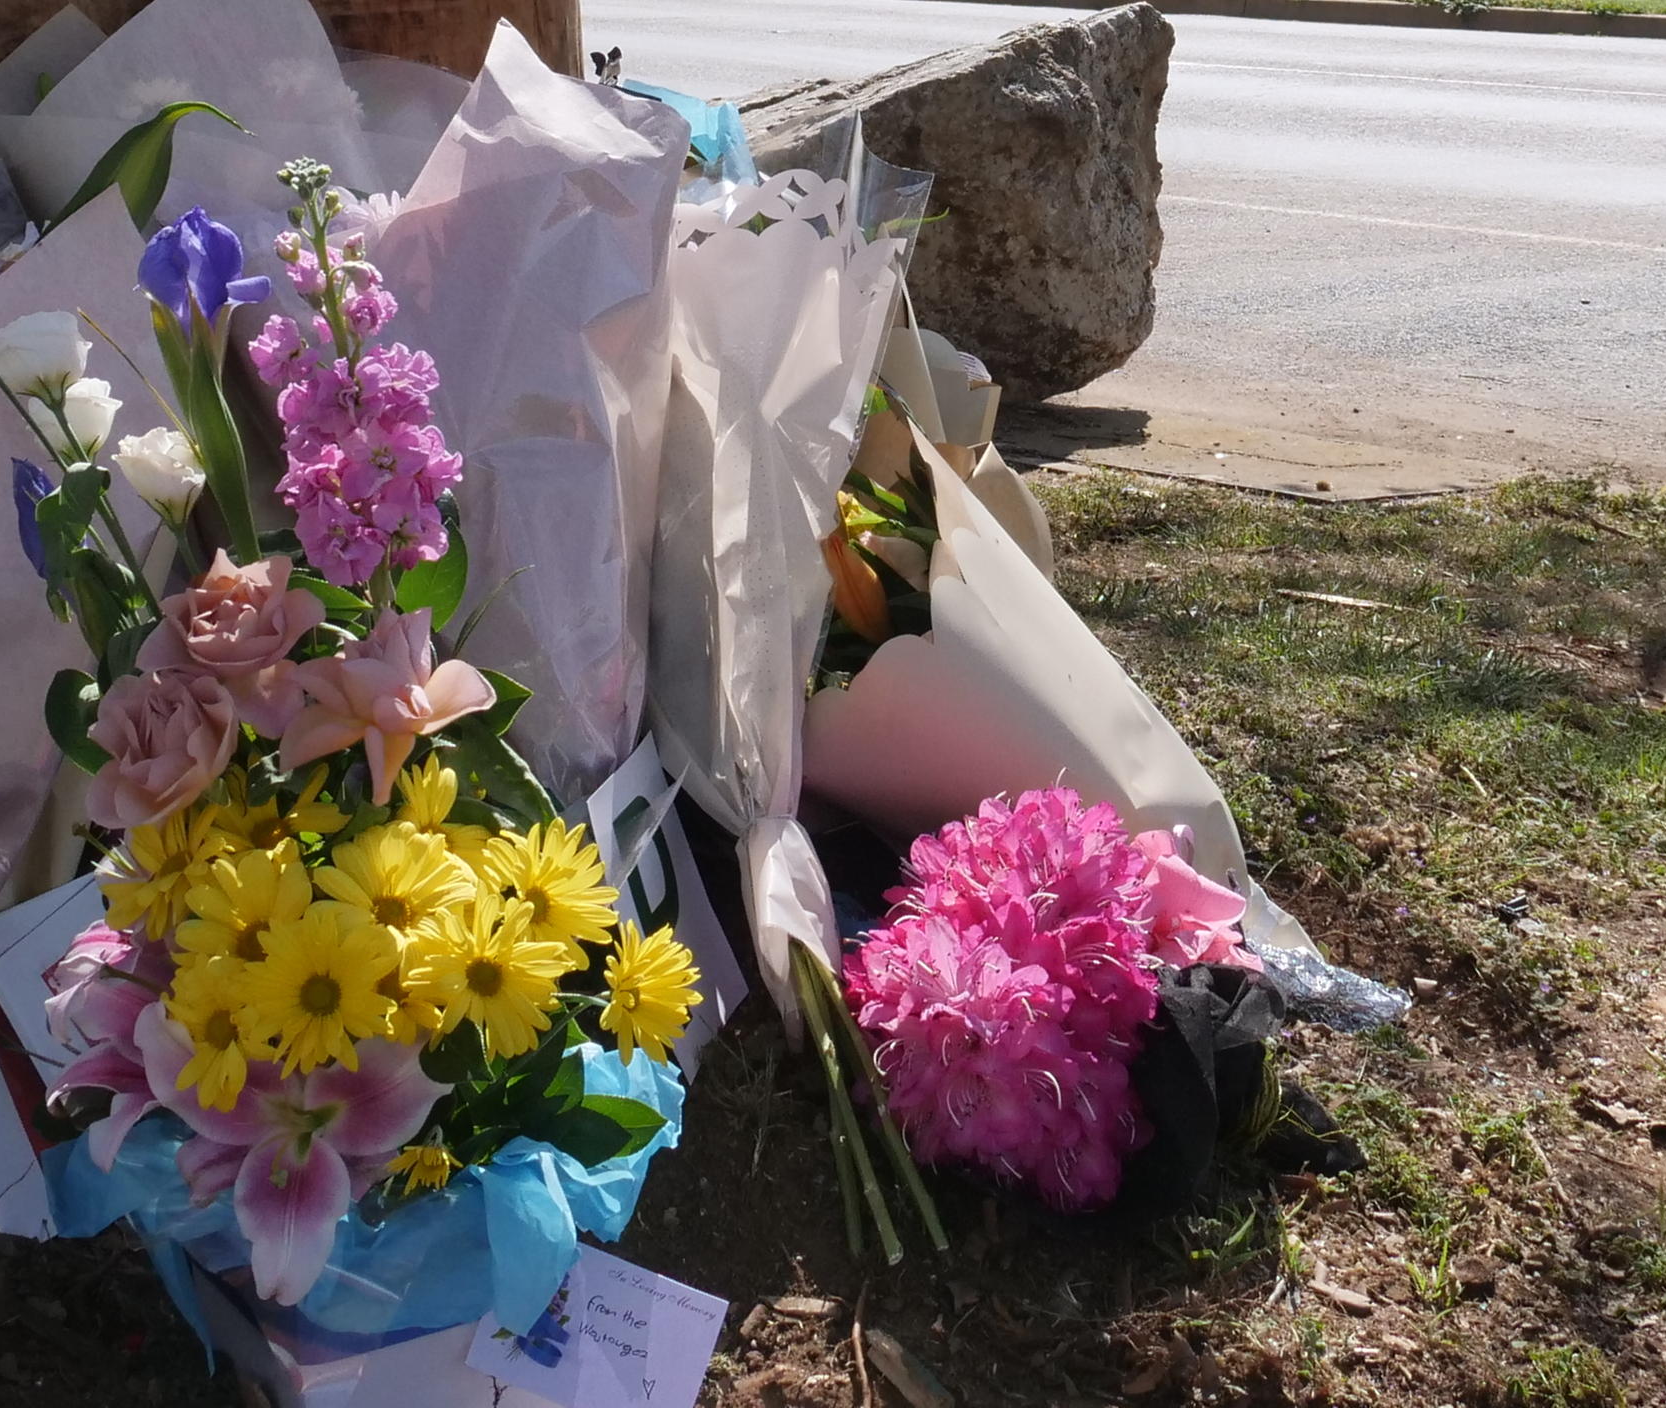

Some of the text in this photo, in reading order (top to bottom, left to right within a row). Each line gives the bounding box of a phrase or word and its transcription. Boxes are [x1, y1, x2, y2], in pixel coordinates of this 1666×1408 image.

[632, 1276, 667, 1301] Loving
[668, 1295, 717, 1322] Memory
[622, 1309, 648, 1330] the
